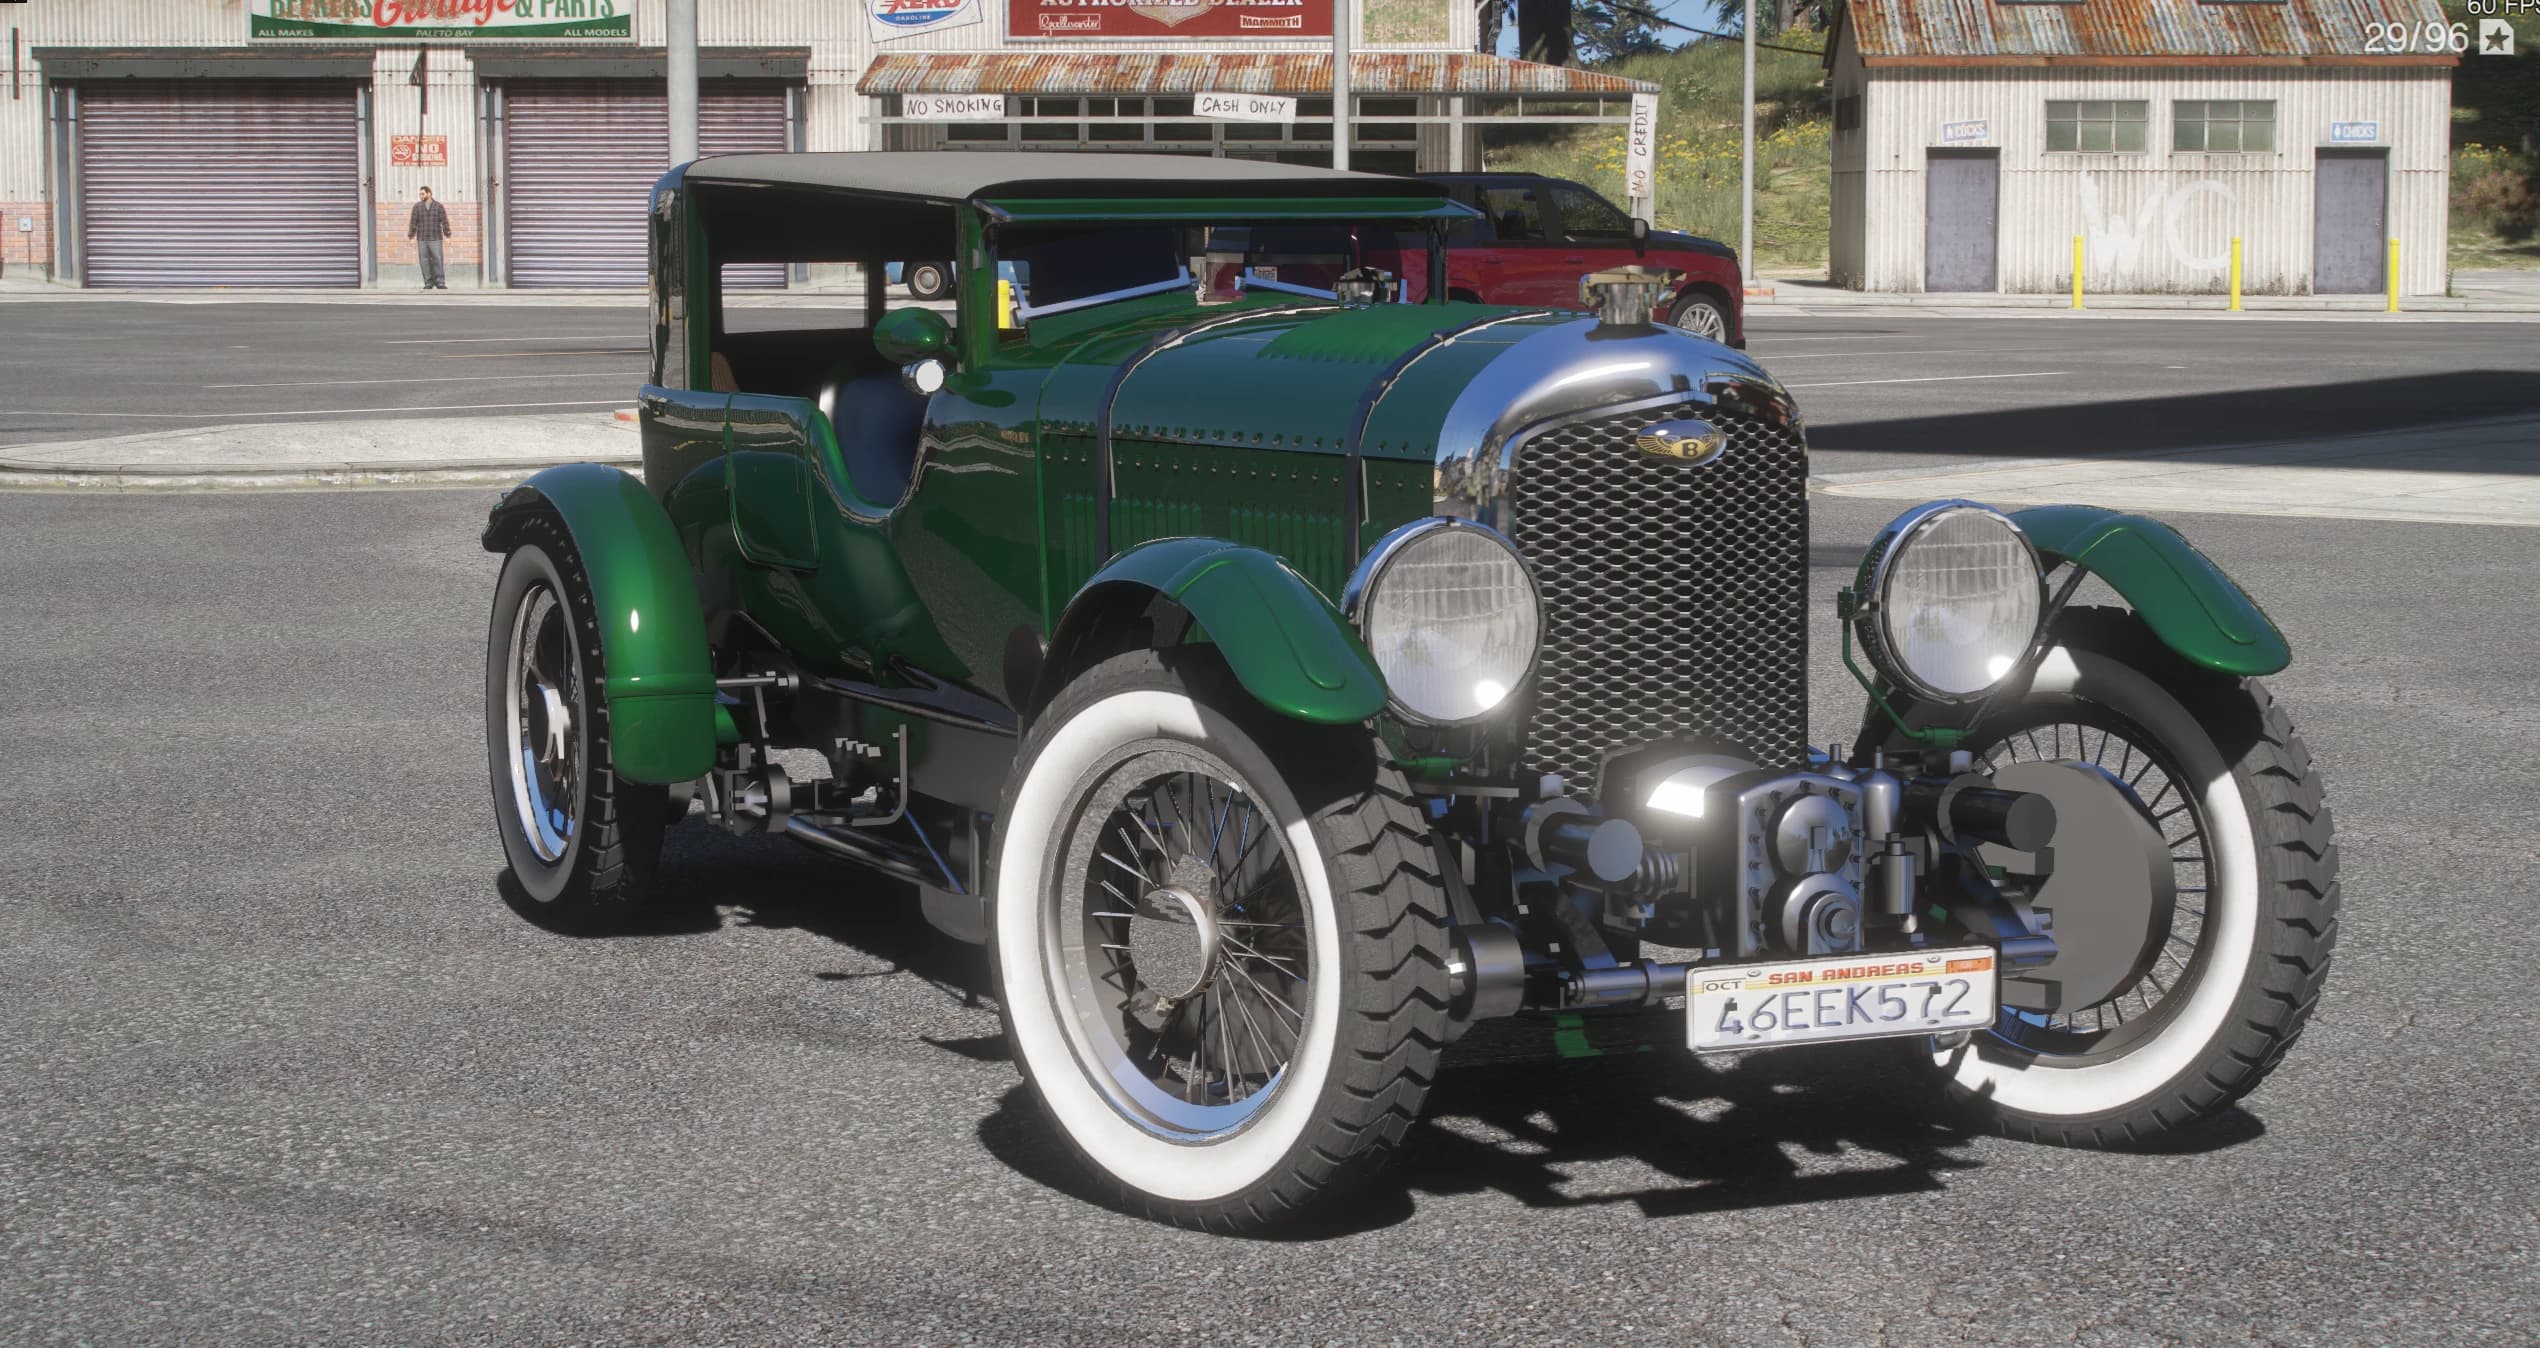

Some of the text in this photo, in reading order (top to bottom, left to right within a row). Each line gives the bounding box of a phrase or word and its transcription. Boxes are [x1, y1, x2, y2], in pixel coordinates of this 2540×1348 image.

[541, 0, 615, 18] PARTS
[1242, 16, 1300, 27] MAMMOTH
[258, 29, 315, 37] ALL MAKES
[563, 28, 628, 37] ALL MODELS
[906, 98, 1002, 116] NO SMOKING
[1202, 97, 1286, 115] CASH ONLY
[414, 143, 440, 154] NO
[1631, 98, 1649, 193] NO CREDIT
[2080, 170, 2237, 273] WC
[1682, 441, 1699, 457] B
[1704, 962, 1925, 993] OCT SAN ANDREAS
[1715, 978, 1971, 1035] 46EEK572
